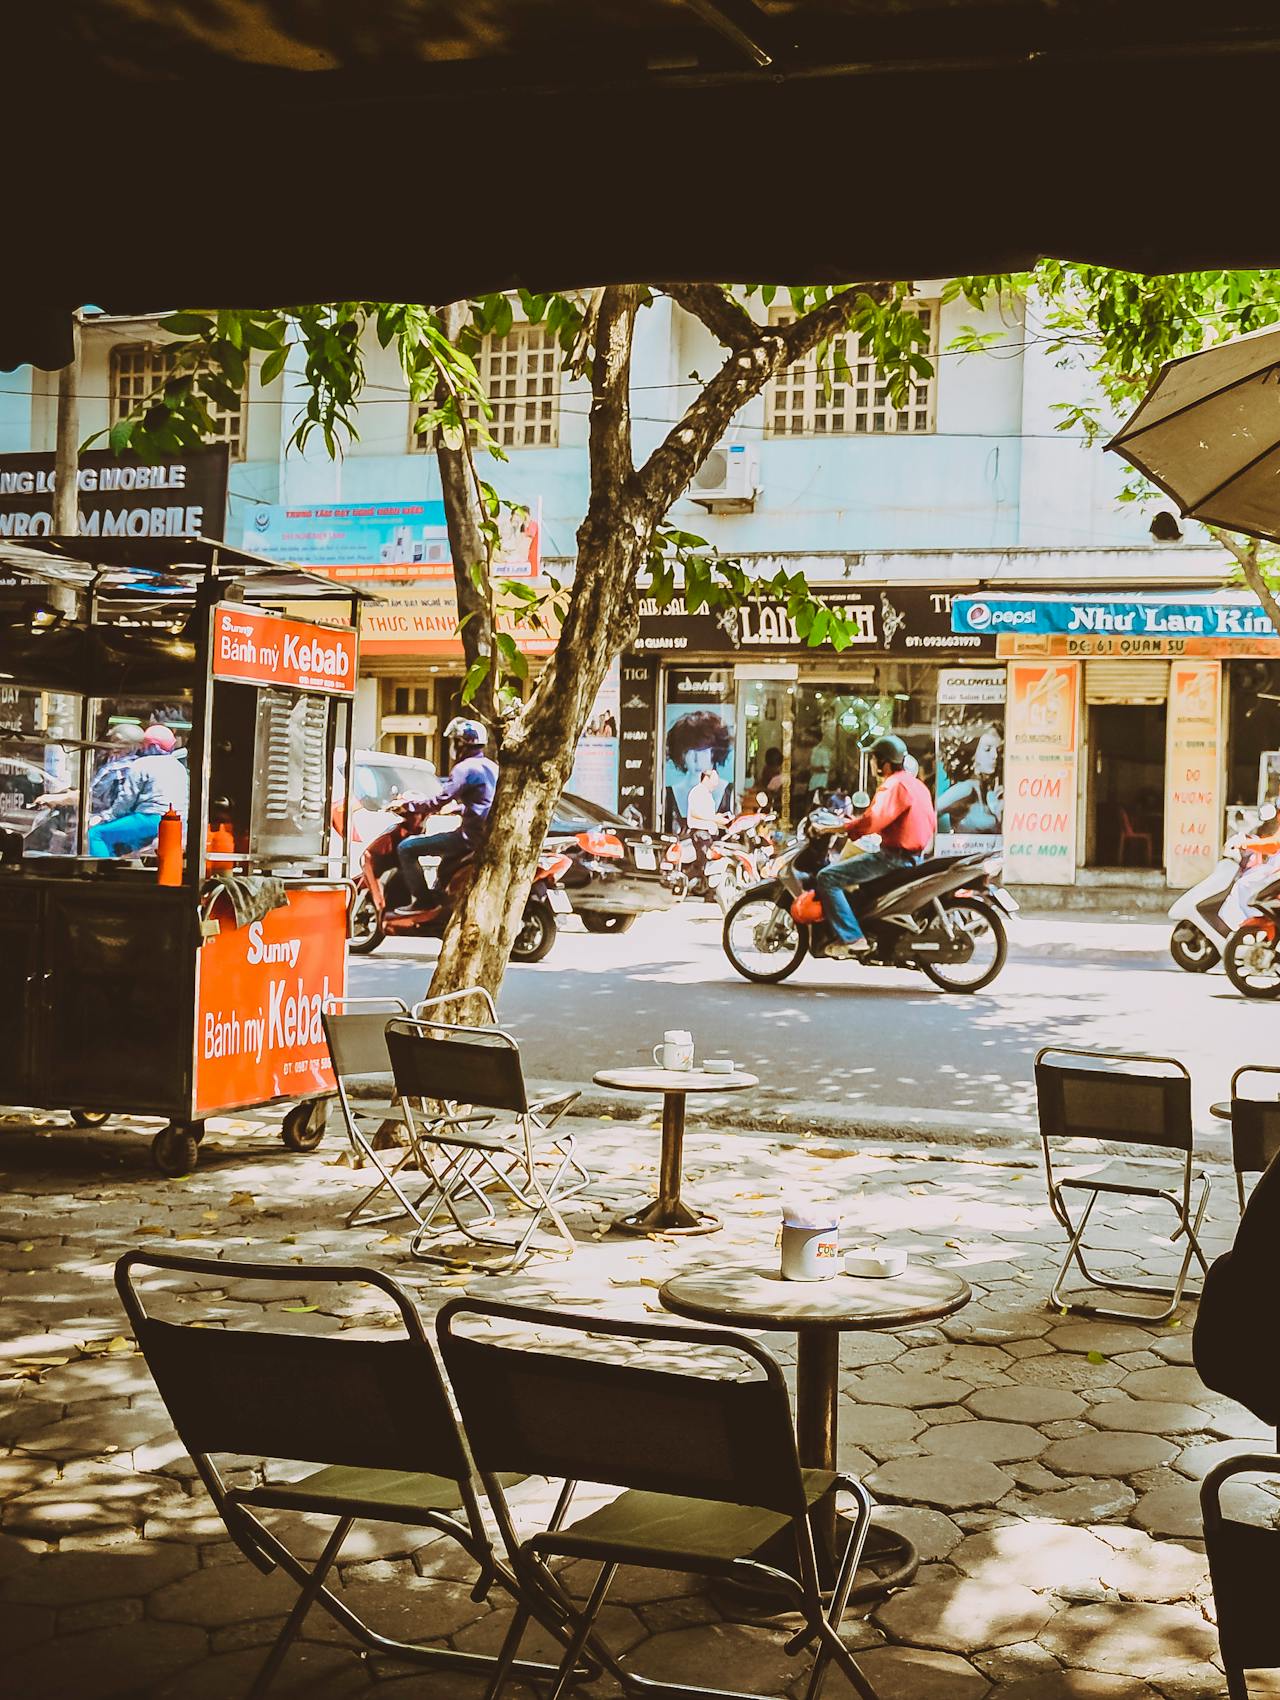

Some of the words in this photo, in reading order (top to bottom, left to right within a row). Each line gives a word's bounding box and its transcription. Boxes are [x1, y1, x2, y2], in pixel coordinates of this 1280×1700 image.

[99, 464, 187, 491] MOBILE
[102, 505, 204, 537] MOBILE
[221, 616, 254, 637] Sunny
[991, 609, 1036, 626] pepsi
[1067, 606, 1136, 631] Như
[1144, 608, 1203, 632] Lan
[221, 636, 256, 664] Bánh
[283, 634, 349, 676] Kebab
[623, 668, 649, 681] TIGI
[247, 921, 301, 968] Sunny
[204, 1011, 240, 1060] Bánh
[244, 1007, 265, 1065] mỳ
